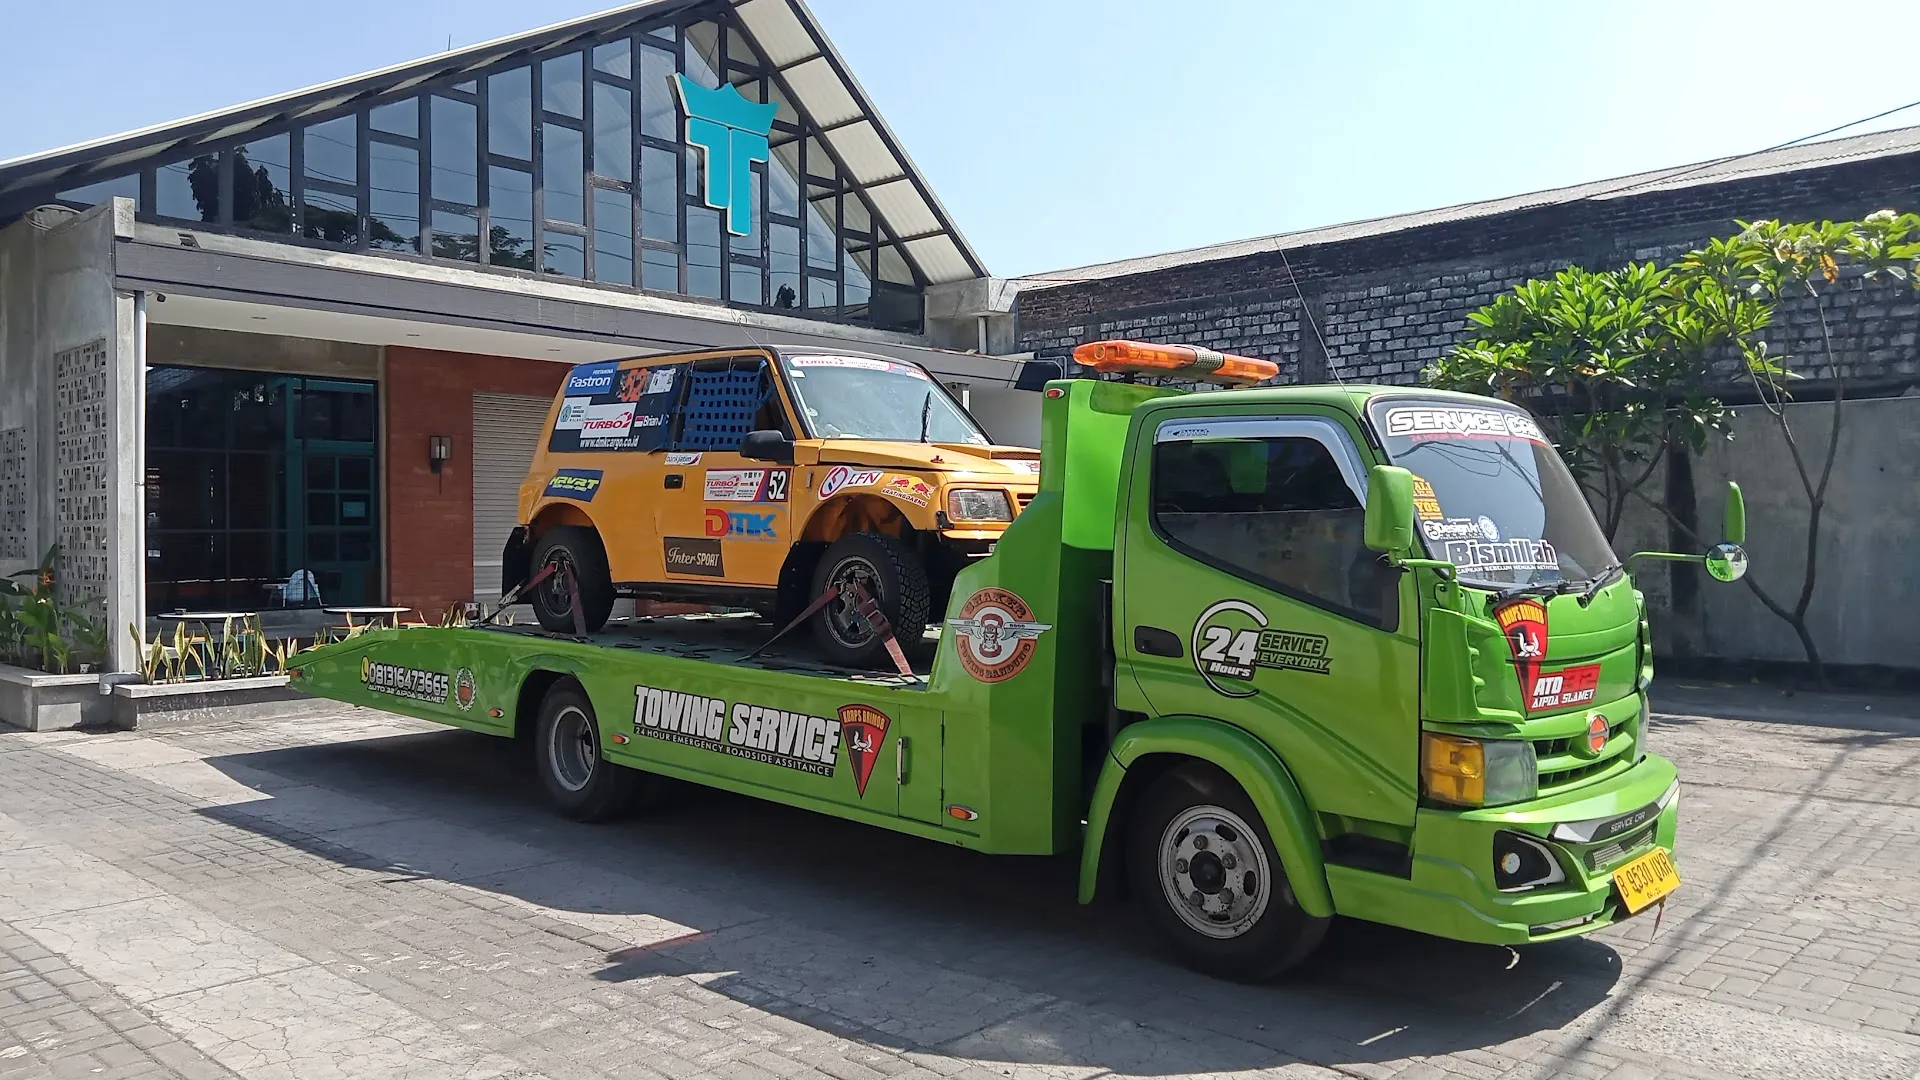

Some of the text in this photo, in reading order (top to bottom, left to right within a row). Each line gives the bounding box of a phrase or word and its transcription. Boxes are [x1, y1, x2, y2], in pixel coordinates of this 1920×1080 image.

[569, 375, 611, 388] Fastron
[584, 420, 622, 430] TURBO
[1389, 411, 1506, 432] SERVICE
[768, 471, 787, 500] 52
[1446, 539, 1558, 567] Bismillah
[1200, 627, 1260, 666] 24
[1259, 633, 1324, 654] SERVICE
[1209, 661, 1251, 677] Hours
[1260, 652, 1330, 670] EVERYDAY
[1533, 676, 1564, 697] ATO
[1562, 688, 1595, 704] SLAMET
[417, 693, 446, 704] SLAMET
[635, 686, 841, 765] TOWING SERVICE
[635, 727, 831, 777] 24 HOUR EMERGENCY ROADSIDE ASSITANCE
[1610, 816, 1634, 834] SERVICE
[1616, 875, 1629, 898] B
[1626, 861, 1654, 894] 9530
